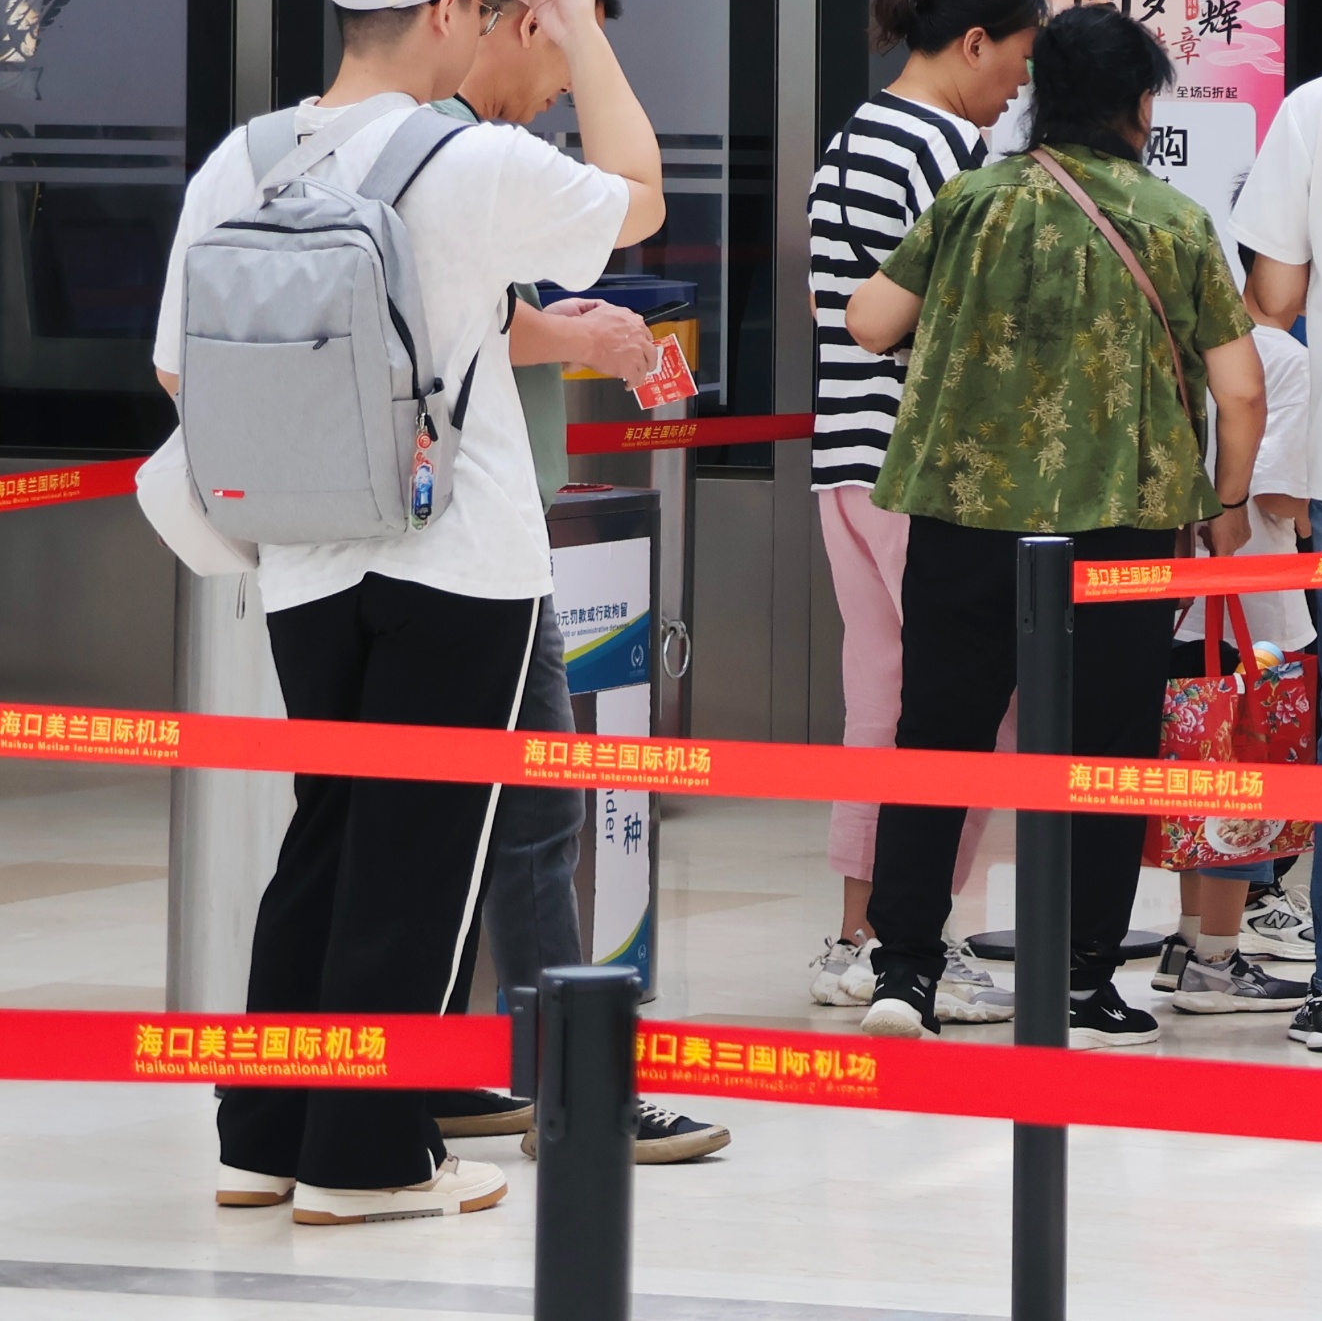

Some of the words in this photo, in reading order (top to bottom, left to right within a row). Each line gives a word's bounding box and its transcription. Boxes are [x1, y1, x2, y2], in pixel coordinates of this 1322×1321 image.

[1176, 86, 1238, 99] 全场5折起
[1086, 565, 1174, 588] 海口美兰国际机场
[0, 712, 180, 744] 海口美兰国际机场
[1, 739, 35, 750] Haikou
[36, 741, 71, 752] Meilan
[72, 744, 140, 756] International
[141, 748, 178, 758] Airport
[524, 740, 711, 772] 海口美兰国际机场
[525, 768, 560, 779] Haikou
[564, 770, 598, 781] Meilan
[601, 772, 669, 785] International
[671, 776, 710, 787] Airport
[1068, 765, 1264, 796] 海口美兰国际机场
[1070, 794, 1106, 804] Haikou
[1110, 795, 1145, 806] Meilan
[1149, 797, 1221, 809] International
[1224, 800, 1263, 812] Airport
[624, 790, 642, 855] 种
[135, 1025, 387, 1060] 海口美兰国际机场
[134, 1060, 185, 1075] Haikou
[188, 1061, 236, 1076] Meilan
[239, 1062, 334, 1077] International
[337, 1063, 388, 1078] Airport
